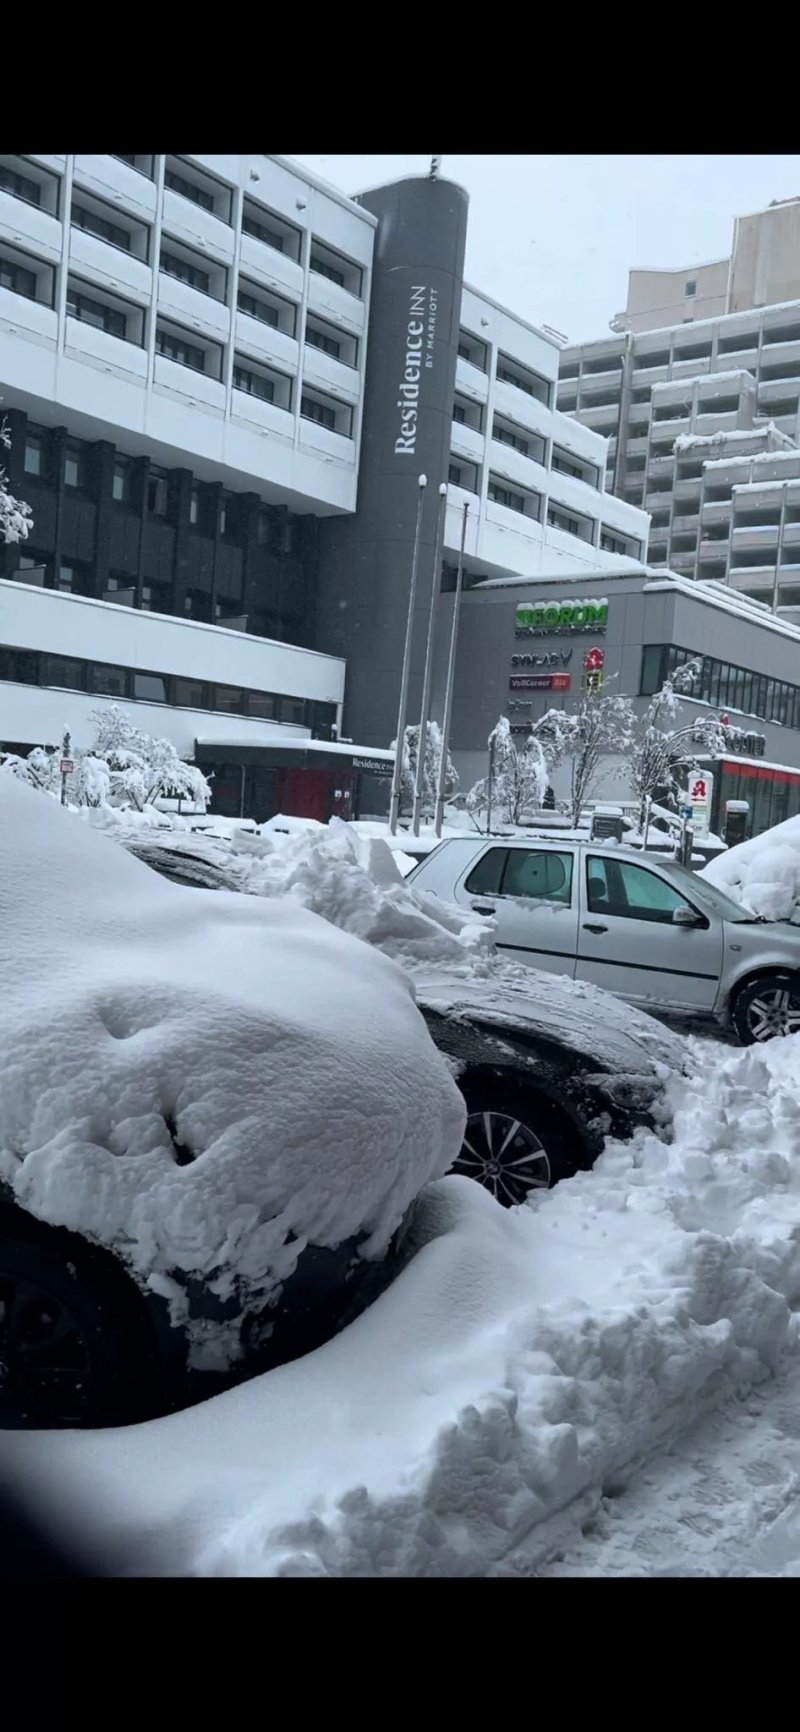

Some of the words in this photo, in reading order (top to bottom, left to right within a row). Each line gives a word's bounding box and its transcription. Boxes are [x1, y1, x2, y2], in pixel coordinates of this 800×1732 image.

[426, 287, 439, 349] MARRIOTT
[394, 320, 424, 455] Residence
[409, 285, 427, 316] INN
[425, 353, 434, 369] BY
[530, 603, 608, 627] FORUM
[512, 678, 551, 688] VollCorner
[352, 757, 386, 770] Residence
